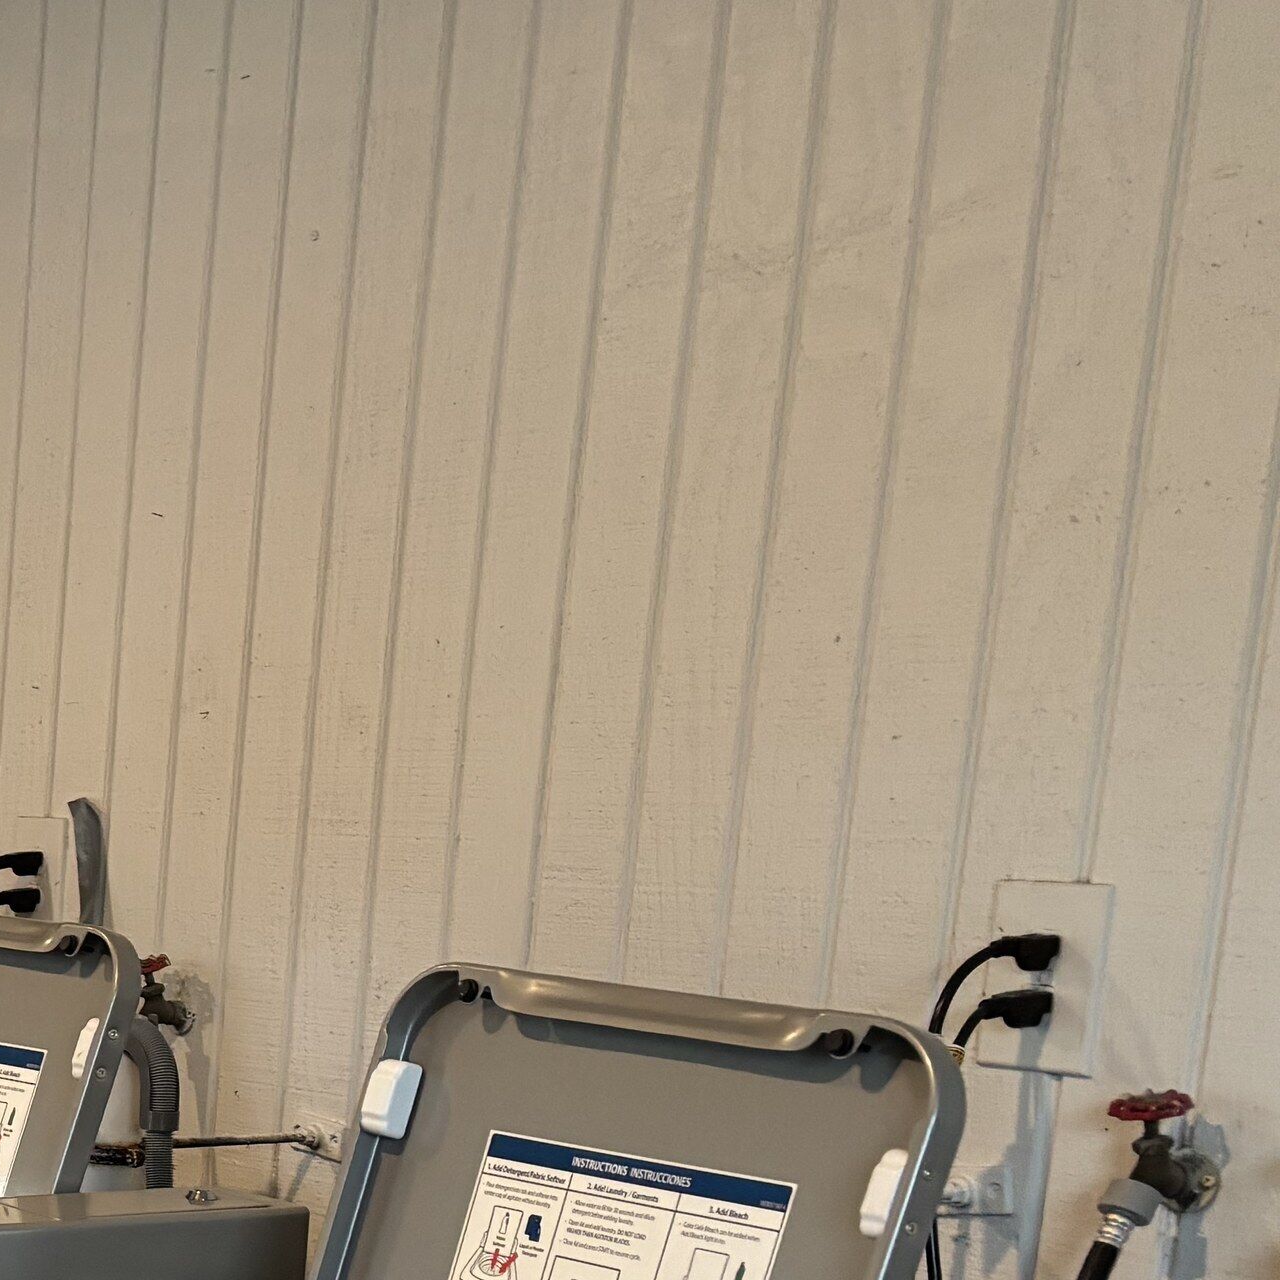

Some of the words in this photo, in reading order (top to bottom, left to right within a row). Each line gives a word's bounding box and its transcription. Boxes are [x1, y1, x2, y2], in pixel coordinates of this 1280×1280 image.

[571, 1156, 629, 1176] INSTRUCTIONS
[630, 1168, 692, 1188] INSTRUCCIONES
[606, 1185, 628, 1198] Laundry
[715, 1206, 729, 1216] Add
[728, 1208, 749, 1220] Bleach
